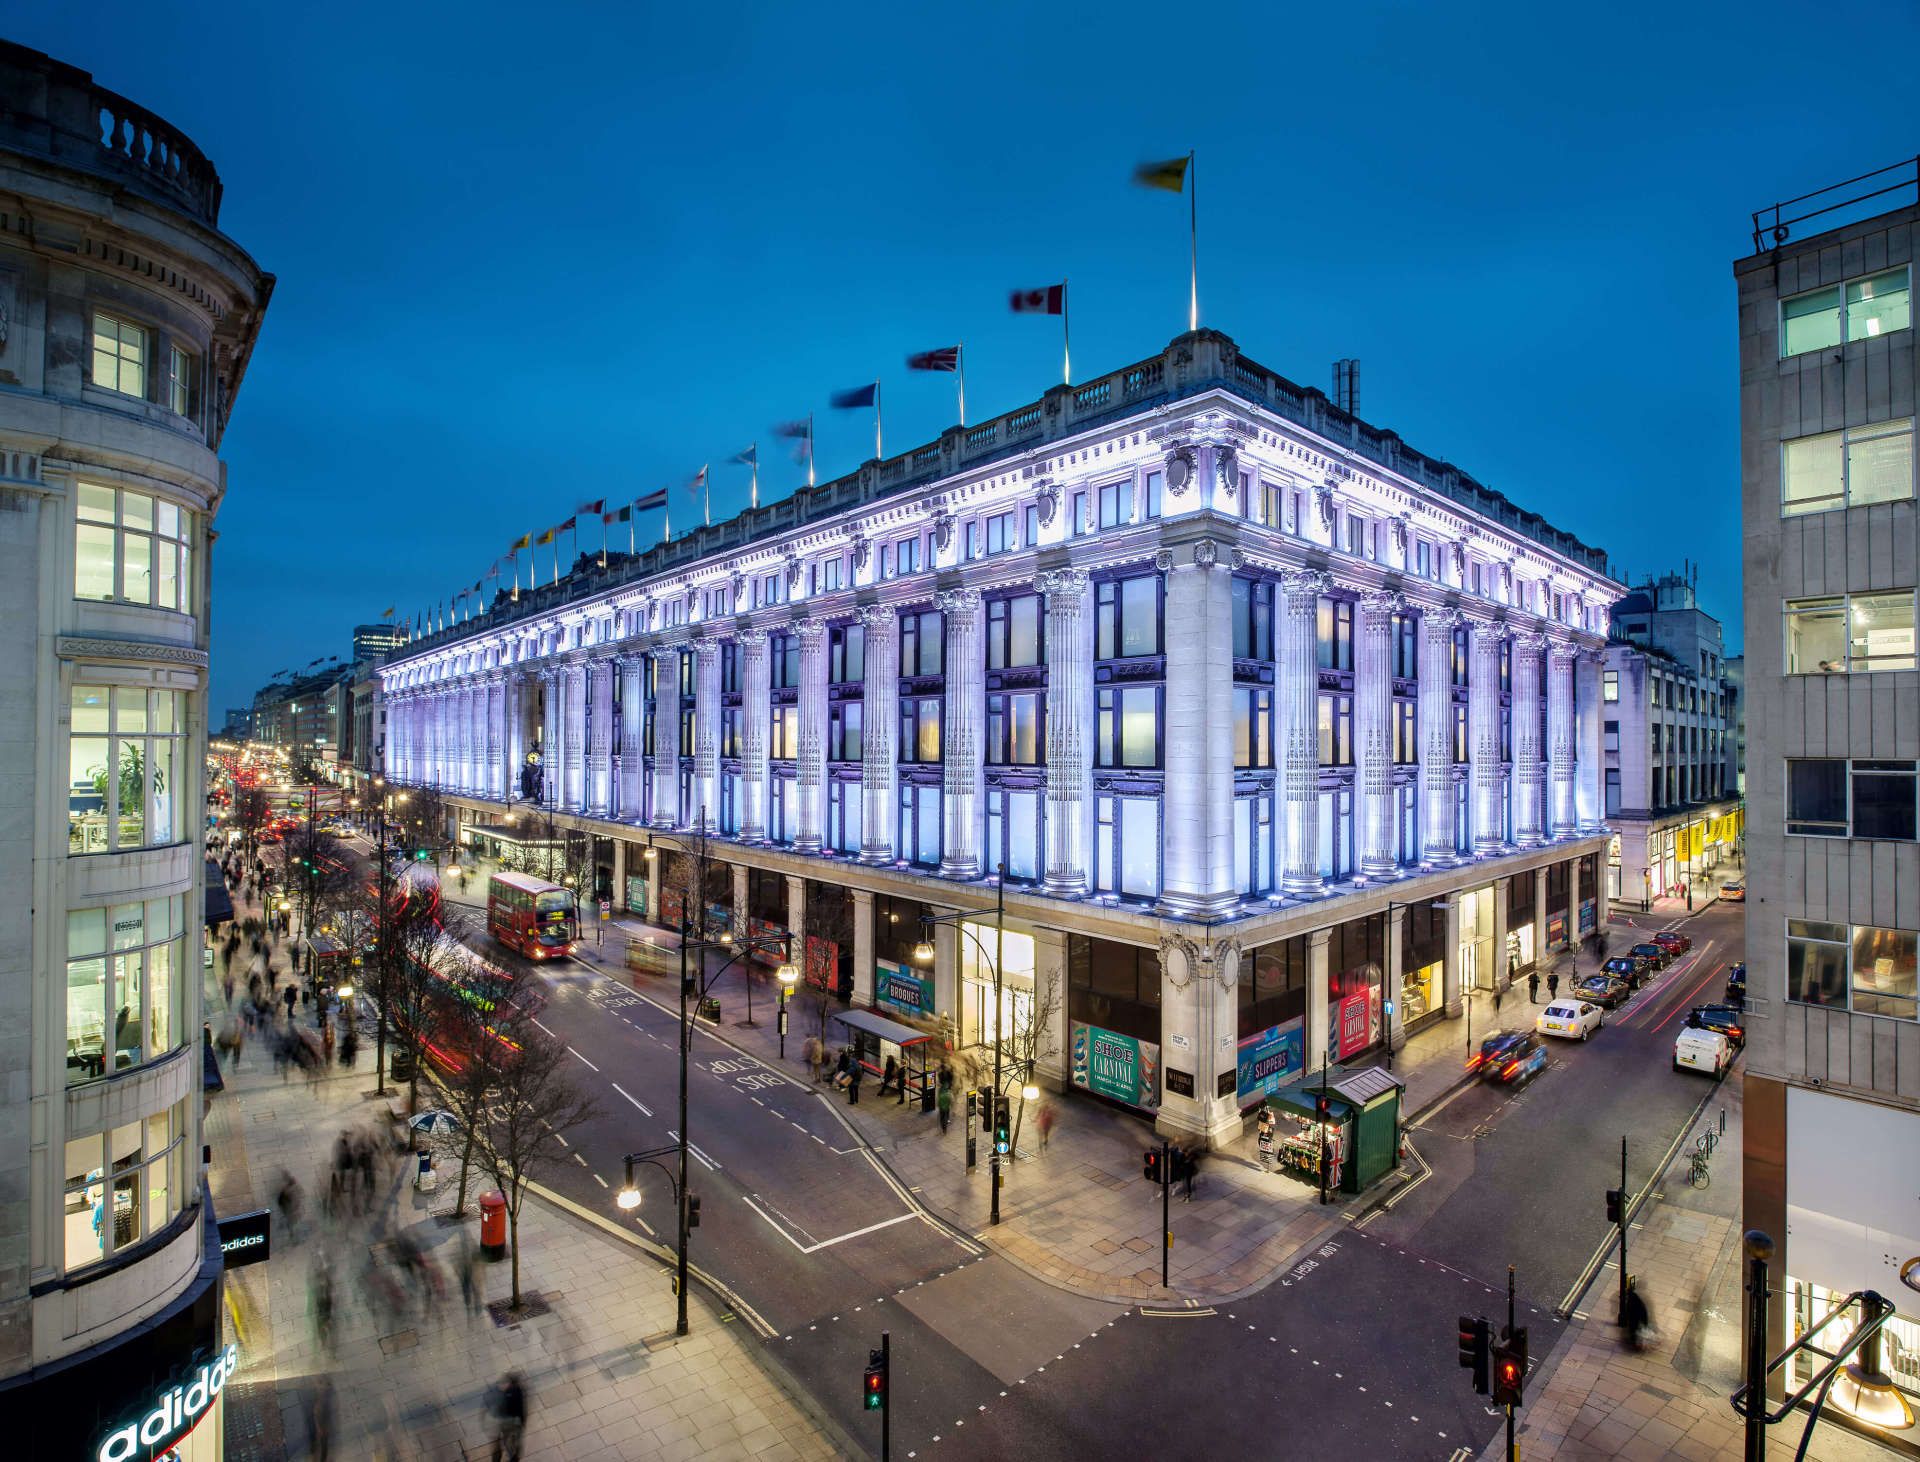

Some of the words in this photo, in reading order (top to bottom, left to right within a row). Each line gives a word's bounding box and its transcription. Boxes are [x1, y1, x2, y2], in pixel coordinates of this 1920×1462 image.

[890, 985, 920, 1006] BROGUES
[1094, 1039, 1134, 1063] SHOE
[709, 1056, 761, 1074] STOP
[1094, 1055, 1133, 1085] CARNIVAL
[1255, 1052, 1287, 1078] SLIPPERS
[736, 1073, 786, 1090] BUS
[220, 1235, 264, 1252] adidas
[1316, 1241, 1343, 1258] LOOK
[1290, 1259, 1320, 1281] RIGHT
[99, 1343, 238, 1462] adidas
